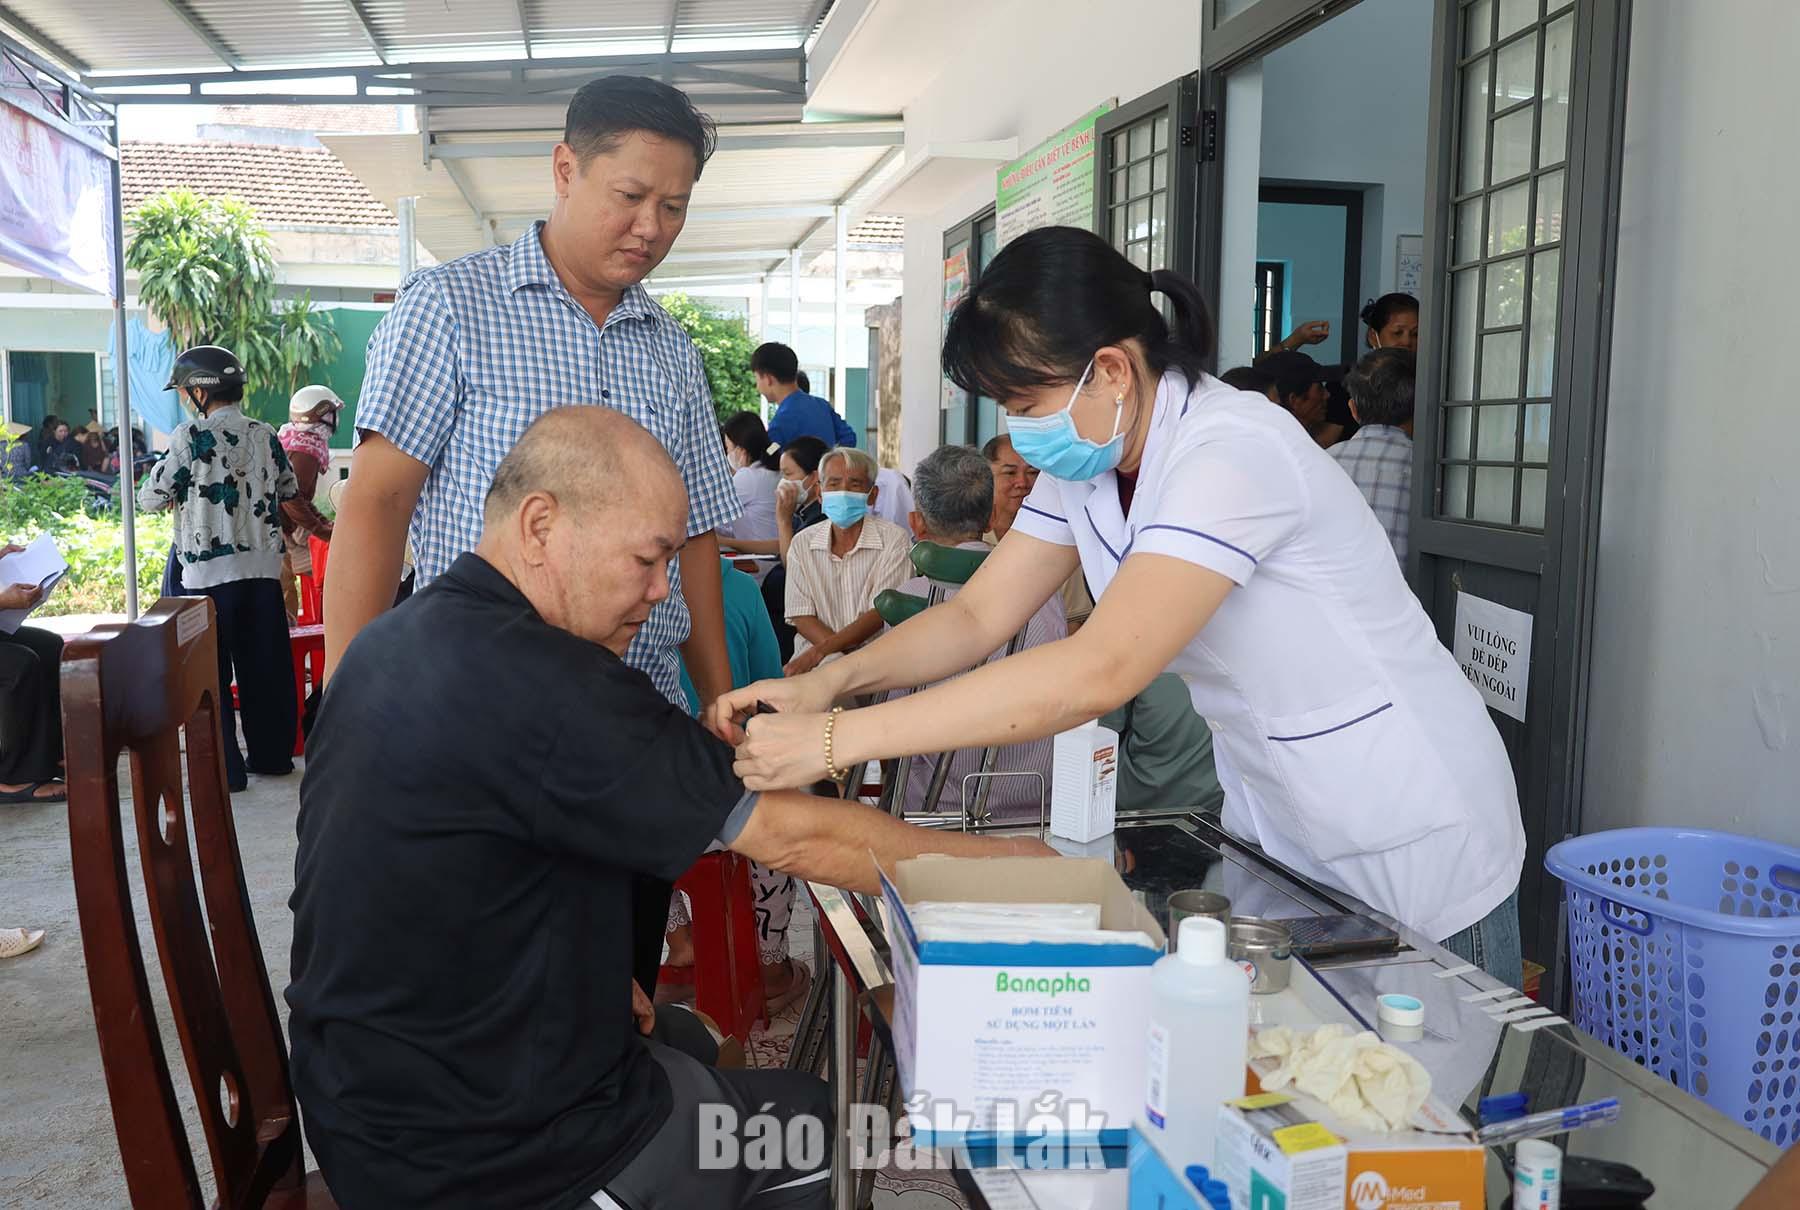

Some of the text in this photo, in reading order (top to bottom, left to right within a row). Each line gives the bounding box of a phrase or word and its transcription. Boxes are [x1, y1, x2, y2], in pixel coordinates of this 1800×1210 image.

[1467, 623, 1517, 656] VUI LÒNG
[1487, 653, 1508, 674] DÉP
[1481, 672, 1516, 702] NGOÀI
[996, 971, 1090, 998] Banapha
